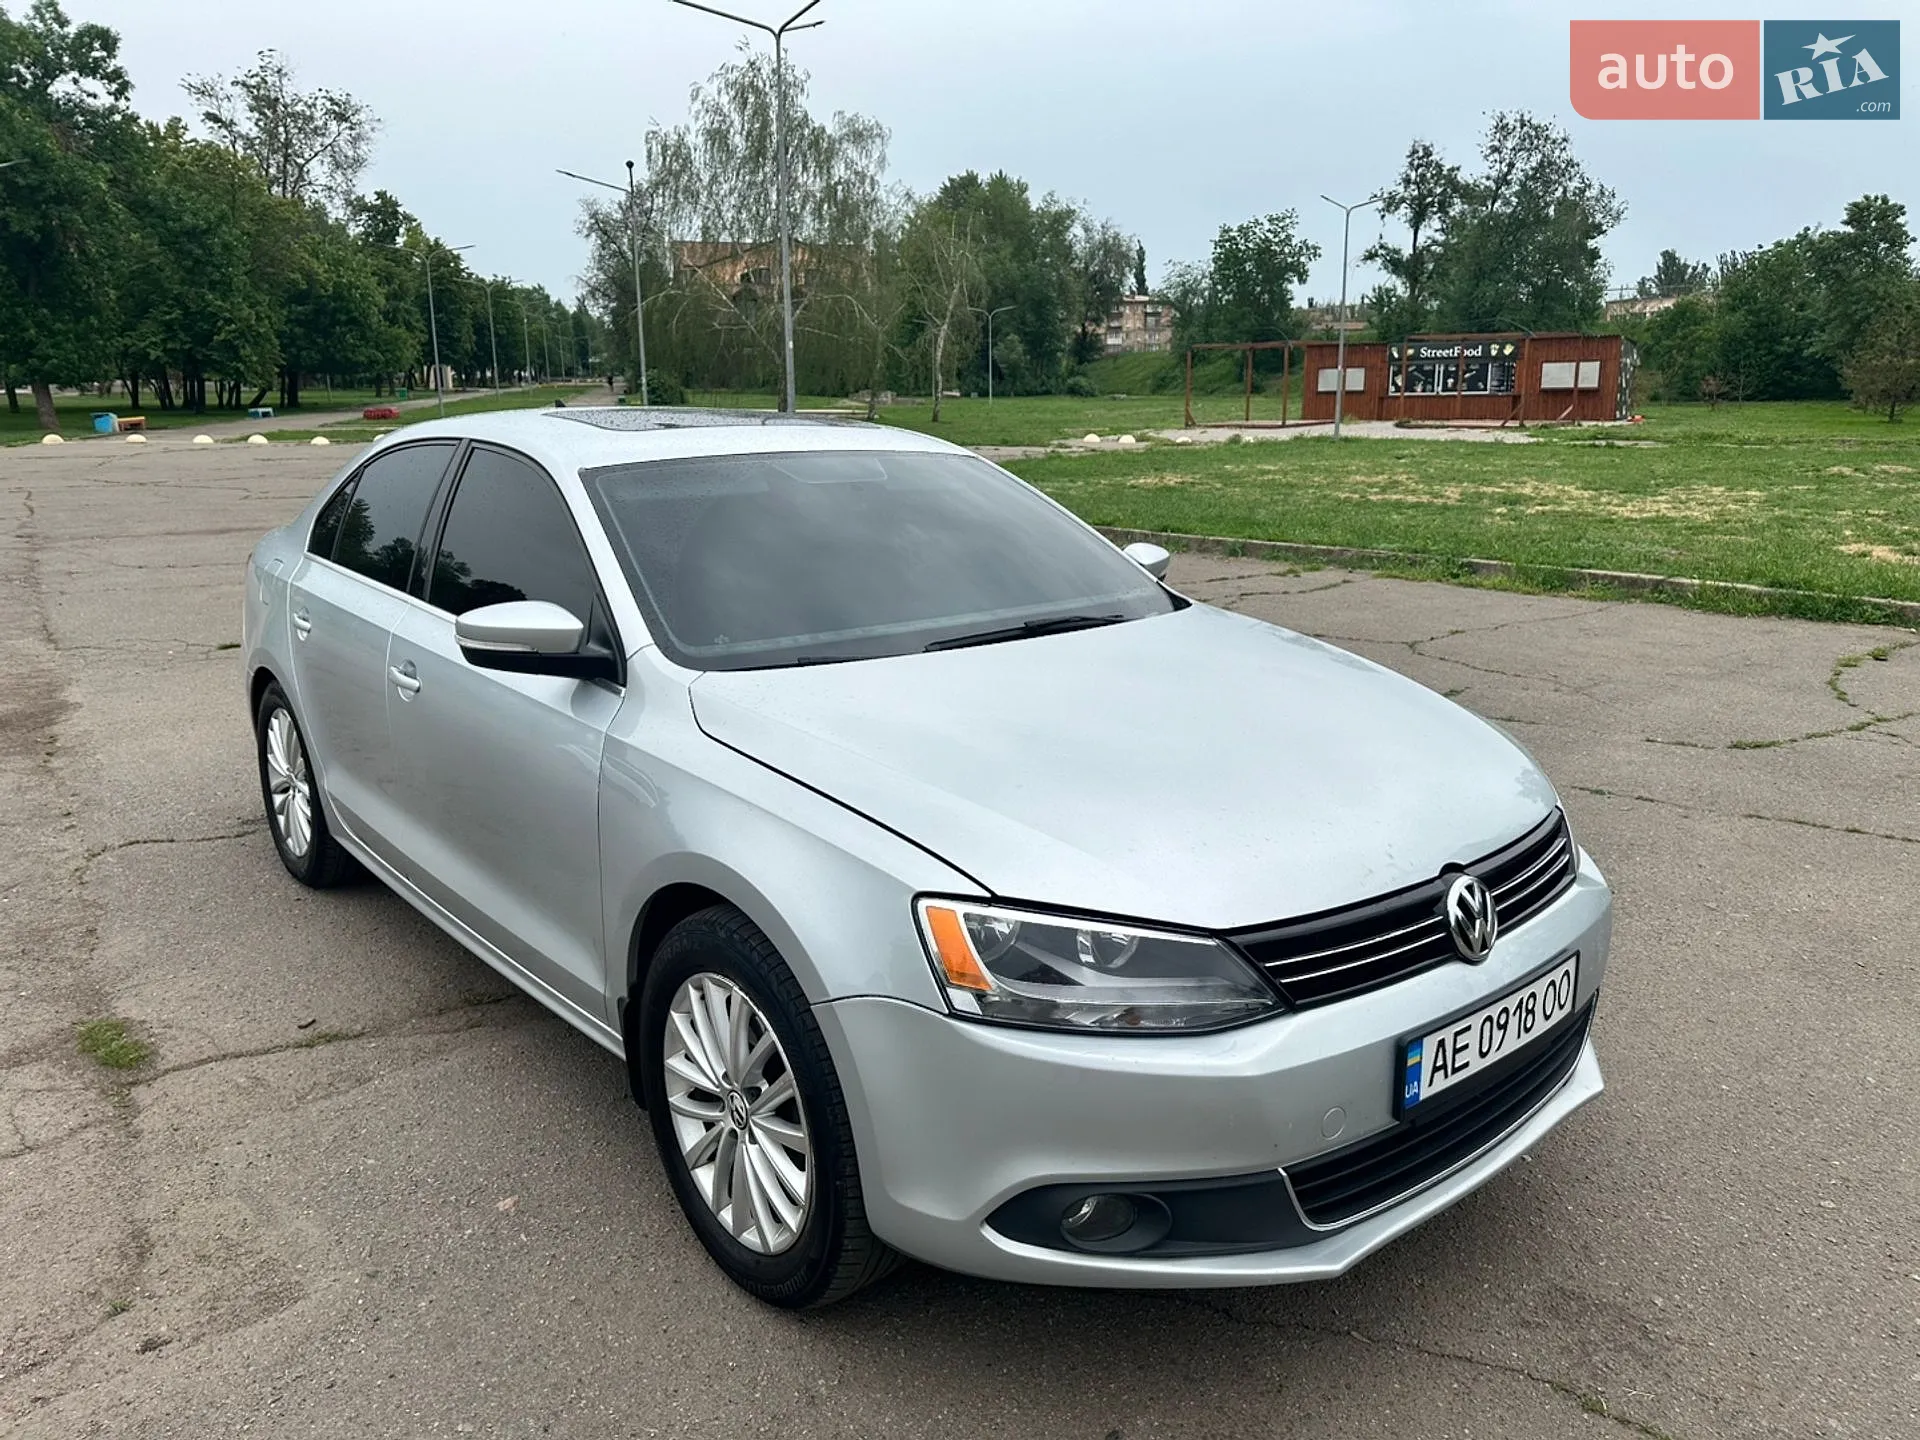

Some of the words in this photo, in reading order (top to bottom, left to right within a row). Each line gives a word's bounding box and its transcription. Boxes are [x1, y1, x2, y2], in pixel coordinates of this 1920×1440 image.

[1428, 1024, 1472, 1088] AE
[1478, 992, 1537, 1059] 0918
[1405, 1081, 1418, 1098] UA
